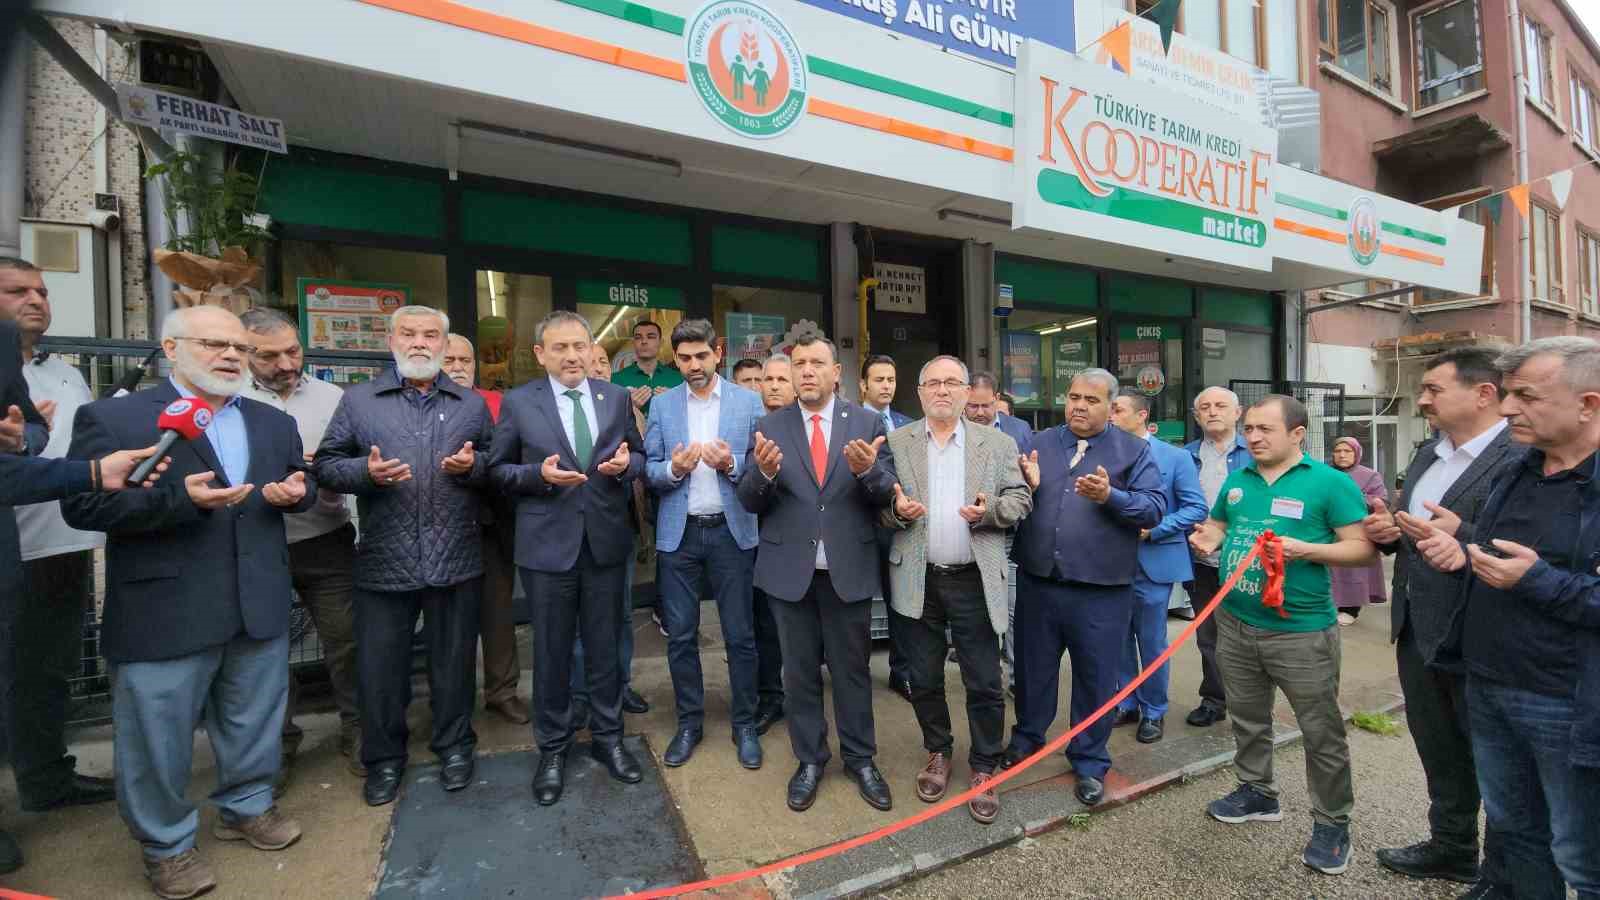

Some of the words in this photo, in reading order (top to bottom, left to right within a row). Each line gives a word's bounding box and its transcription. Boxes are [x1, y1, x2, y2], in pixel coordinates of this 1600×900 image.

[905, 0, 944, 34] Ali
[949, 13, 1023, 57] GÜNE
[156, 94, 232, 126] FERHAT
[239, 113, 280, 138] SALT
[1094, 94, 1156, 132] TÜRKİYE
[1161, 118, 1202, 147] TARIM
[1206, 134, 1241, 158] KREDİ
[1038, 76, 1272, 214] KOOPERATİF
[1202, 216, 1259, 245] market
[609, 283, 649, 306] GİRİŞ
[1136, 326, 1162, 340] ÇIKIŞ
